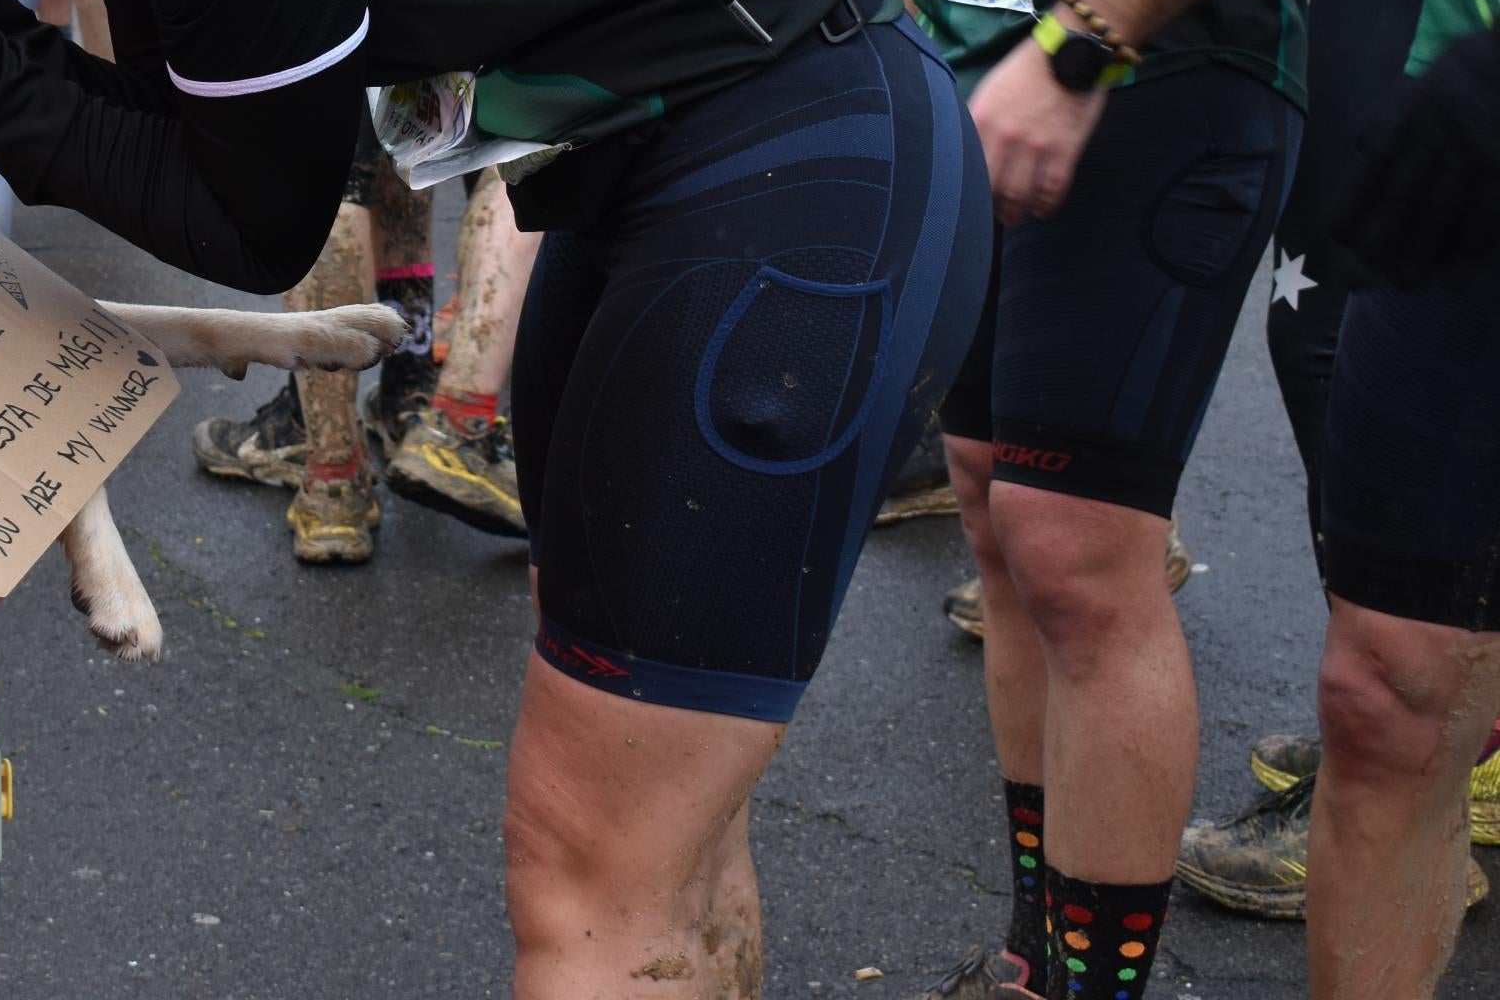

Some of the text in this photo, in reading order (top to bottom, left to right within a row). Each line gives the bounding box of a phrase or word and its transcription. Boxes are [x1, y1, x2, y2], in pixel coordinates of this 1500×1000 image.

[23, 372, 62, 406] DE
[21, 470, 63, 516] ARE
[57, 430, 106, 466] MY
